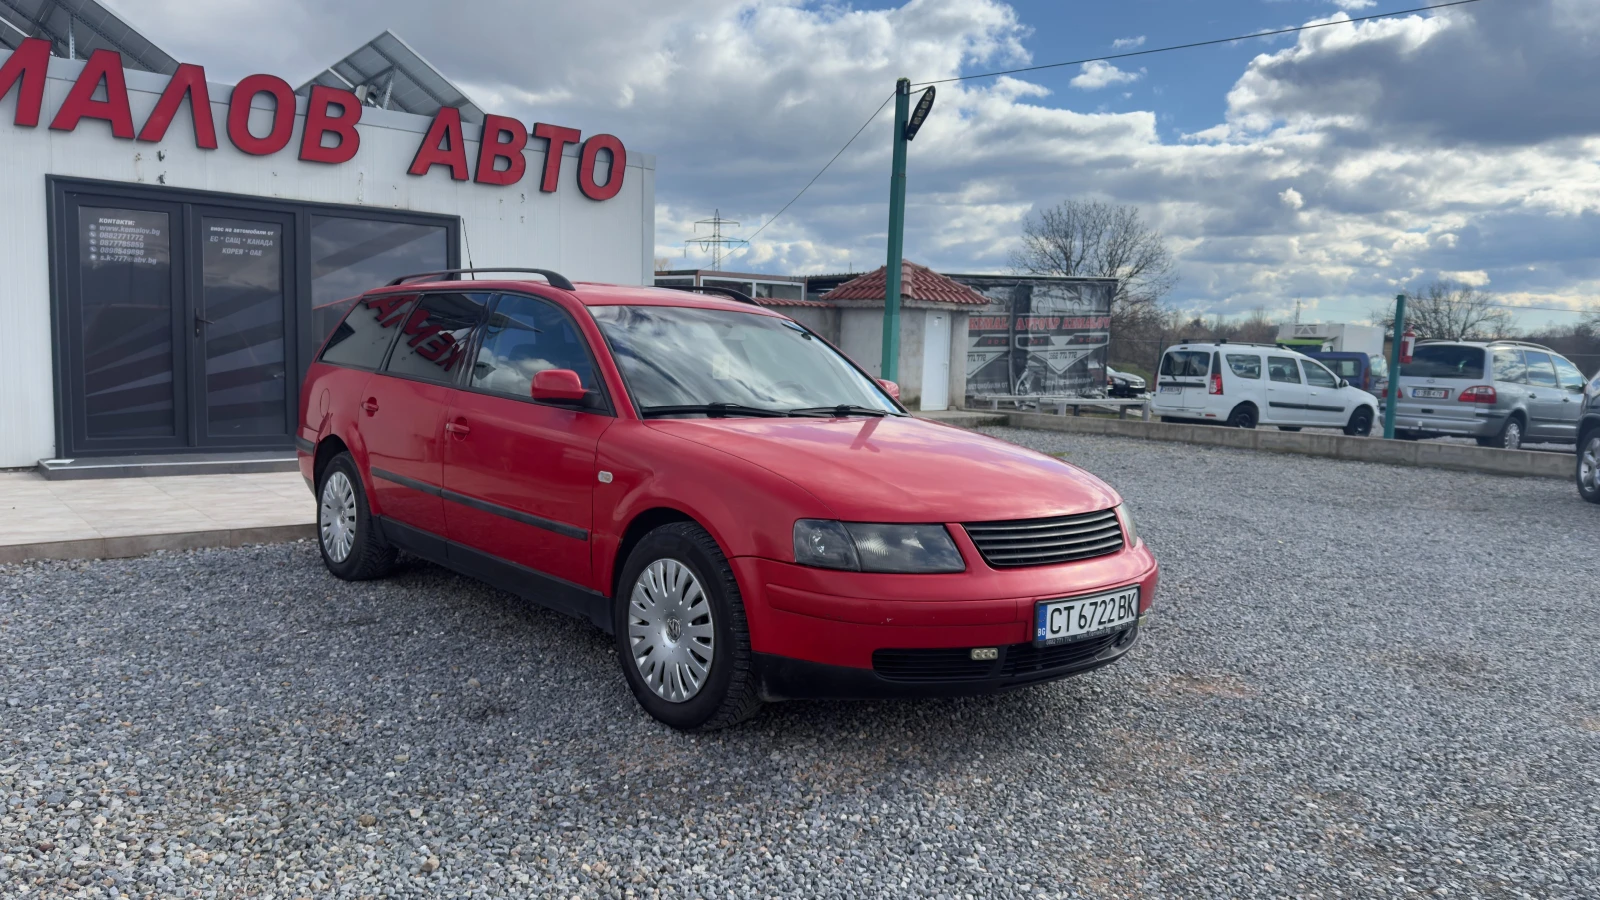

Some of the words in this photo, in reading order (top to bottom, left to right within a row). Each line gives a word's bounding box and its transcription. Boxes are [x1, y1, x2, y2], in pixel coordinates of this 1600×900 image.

[408, 106, 627, 201] АВТО
[99, 225, 161, 237] www.kemalov.bg
[99, 231, 145, 241] 0882771772
[225, 236, 241, 245] САЩ
[246, 238, 273, 247] КАНАДА
[221, 247, 244, 255] КОРЕЯ
[1050, 606, 1075, 634] CT
[1078, 602, 1116, 629] 6722
[1118, 596, 1136, 621] BK
[1037, 628, 1046, 637] BG
